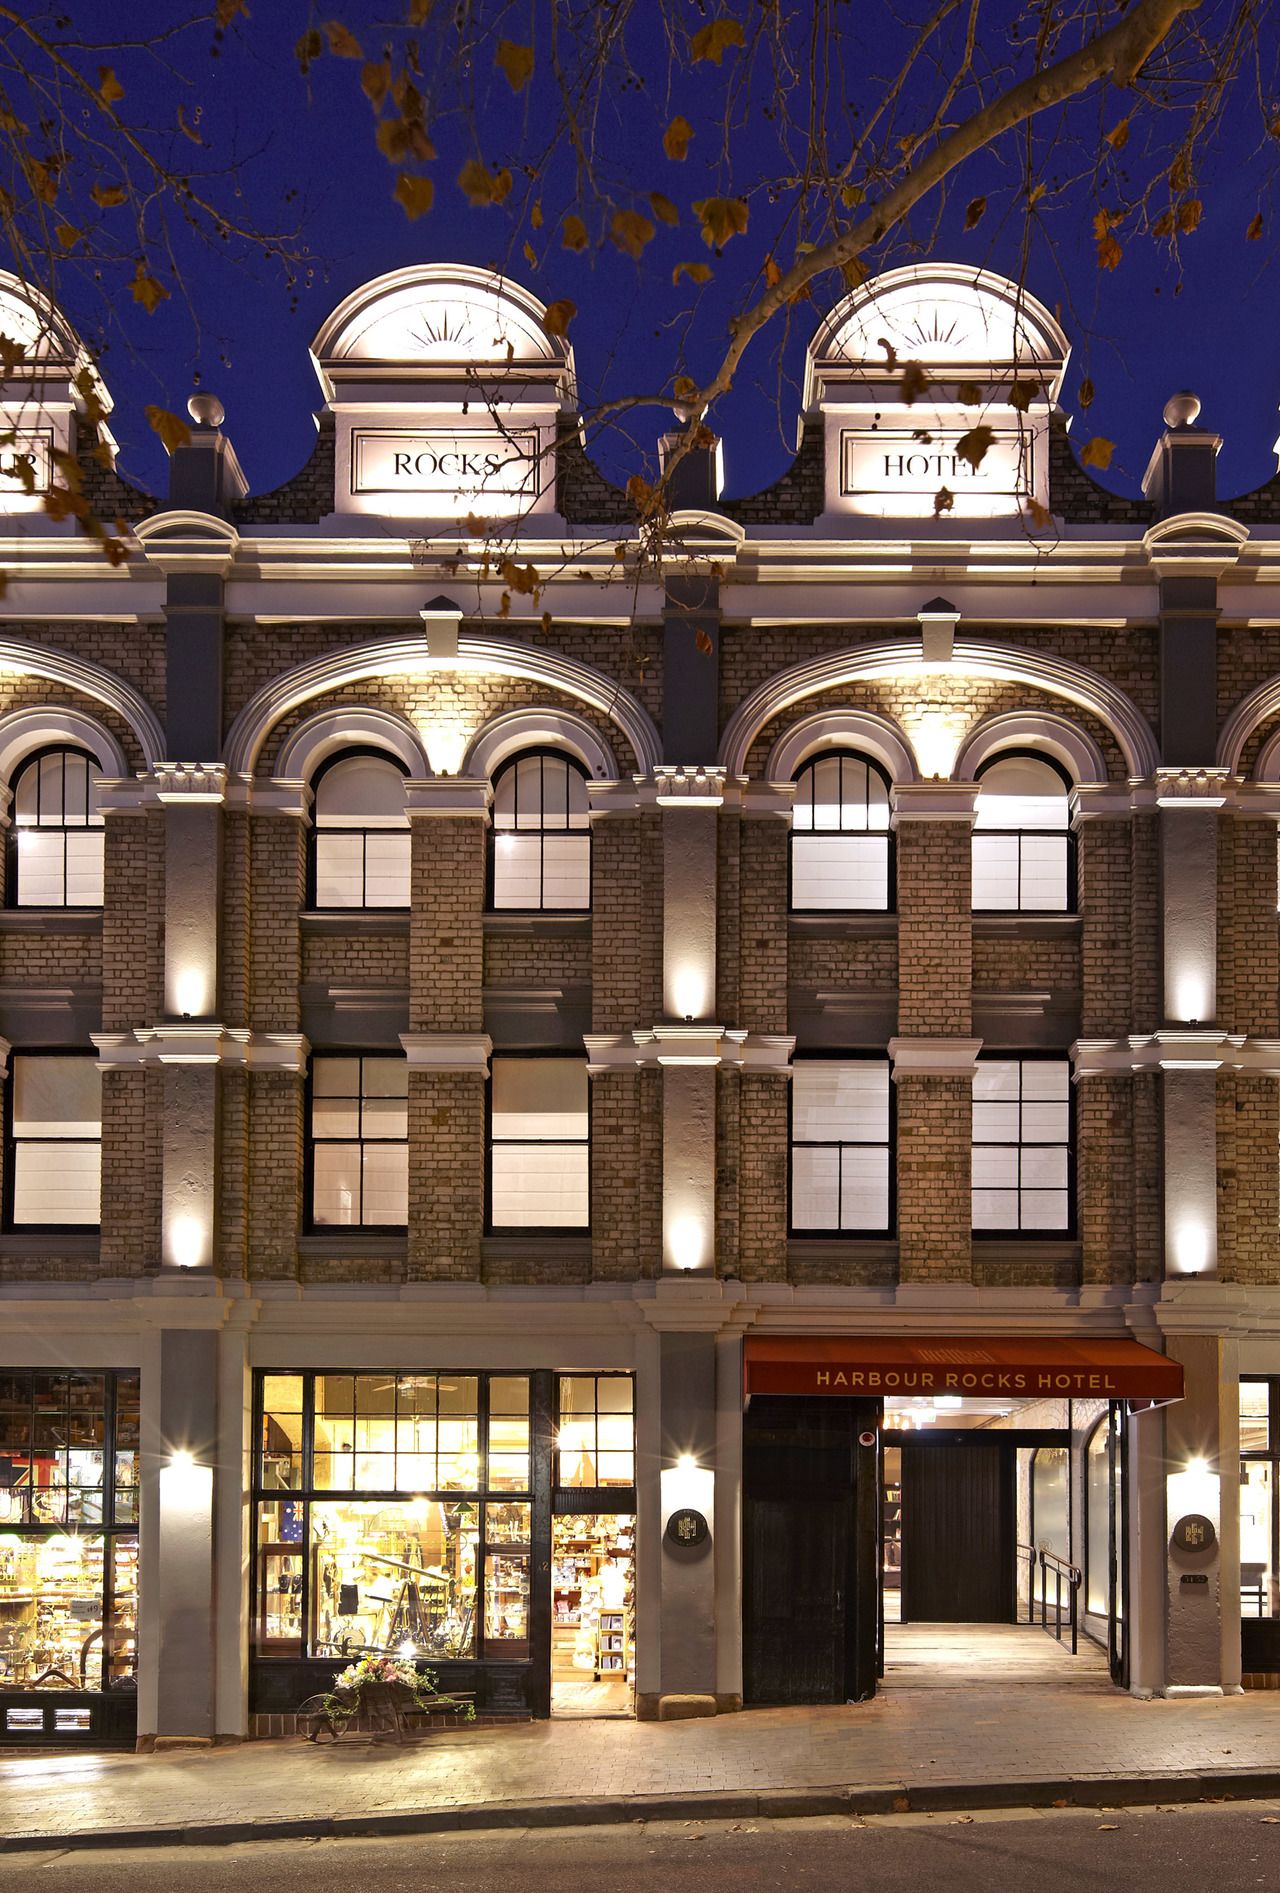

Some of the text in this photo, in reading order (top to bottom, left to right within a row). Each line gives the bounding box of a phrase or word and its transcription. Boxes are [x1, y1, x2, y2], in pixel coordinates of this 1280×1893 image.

[394, 452, 500, 476] ROCKS
[884, 454, 989, 477] HOTEL
[816, 1371, 1116, 1389] HARBOUR ROCKS HOTEL
